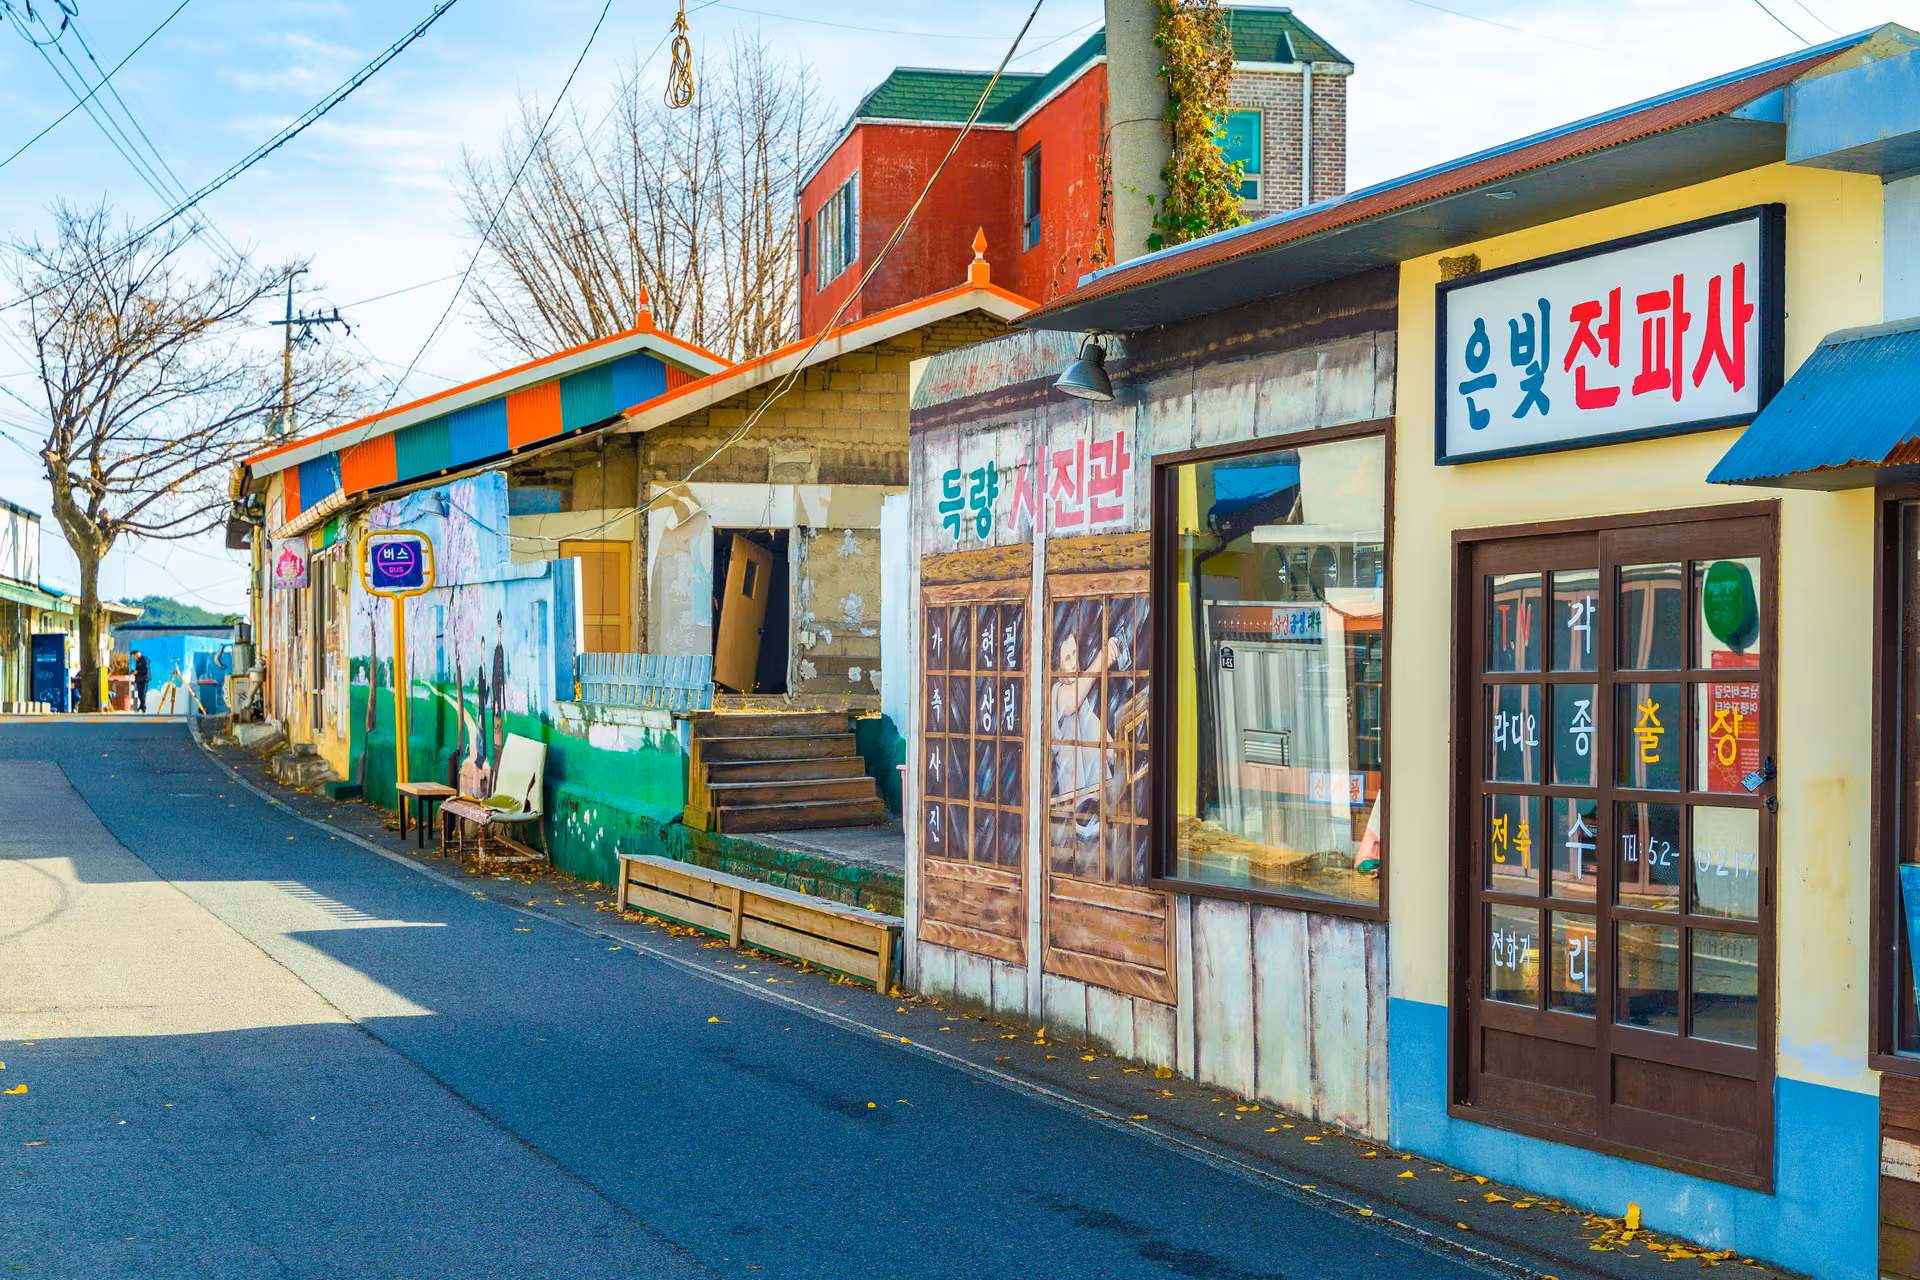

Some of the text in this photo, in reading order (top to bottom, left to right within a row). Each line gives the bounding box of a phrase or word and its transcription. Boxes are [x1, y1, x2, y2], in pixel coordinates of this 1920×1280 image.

[1459, 262, 1754, 431] 은빛 전파사
[939, 431, 1130, 541] 득량 사진관
[383, 547, 409, 561] 버스
[980, 621, 995, 732] 현상
[1493, 710, 1539, 752] 라디오
[1491, 813, 1532, 870] 전축
[1491, 927, 1531, 973] 전화기
